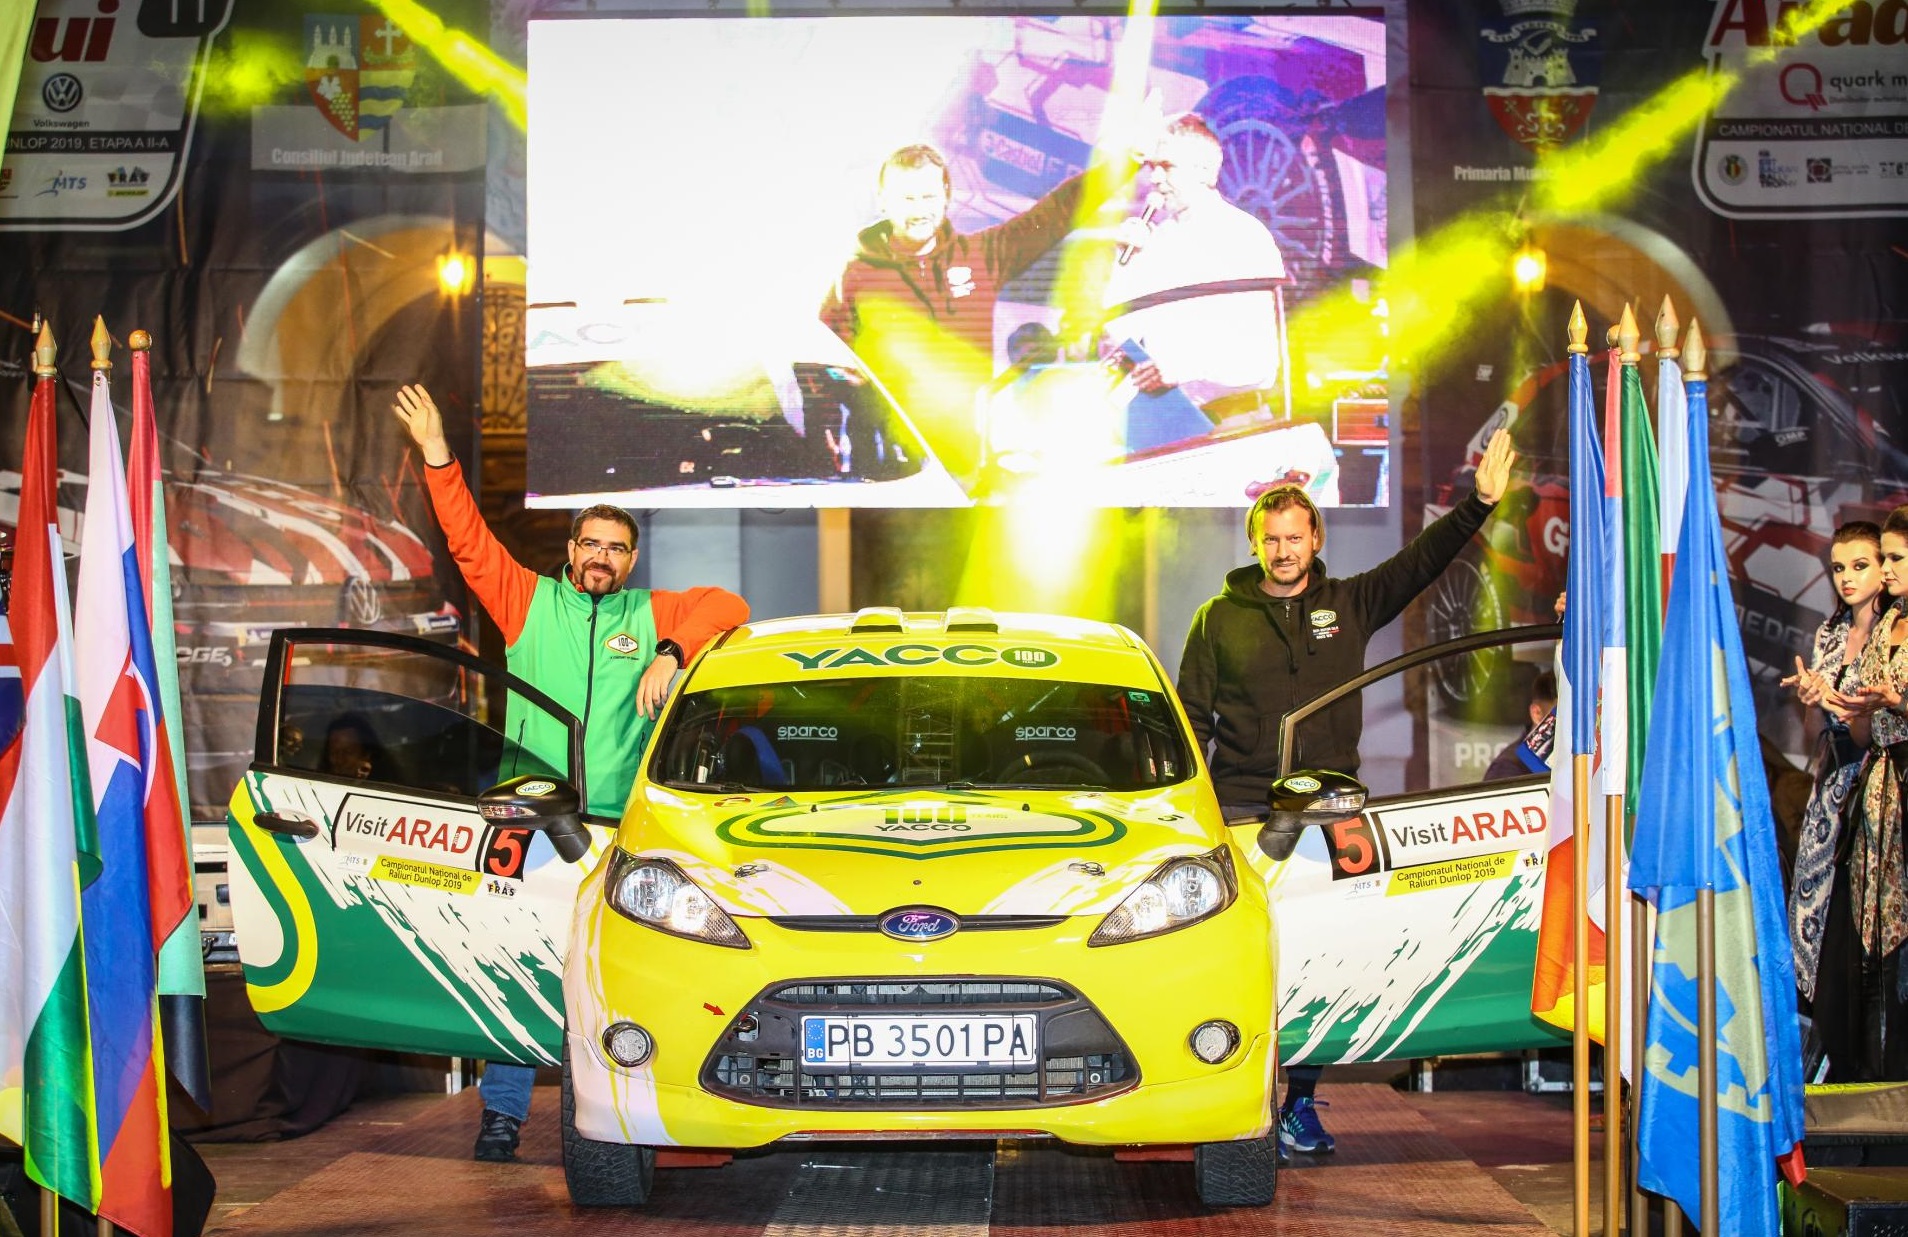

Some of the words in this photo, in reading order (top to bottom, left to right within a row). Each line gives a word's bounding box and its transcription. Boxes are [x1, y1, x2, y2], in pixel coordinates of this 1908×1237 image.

[1830, 70, 1885, 92] quark
[34, 119, 90, 129] Volkswagen
[1718, 125, 1818, 137] CAMPIONATUL
[6, 138, 48, 149] NLOP
[409, 151, 443, 166] Arad
[777, 725, 838, 739] sparco
[1015, 725, 1077, 739] sparco
[522, 784, 551, 792] YACCO
[1290, 780, 1316, 788] YACCO
[345, 811, 388, 837] Visit
[386, 816, 474, 855] ARAD
[875, 824, 972, 832] YACCO
[1391, 822, 1448, 848] Visit
[1451, 805, 1547, 845] ARAD
[488, 828, 530, 877] 5
[1333, 817, 1373, 874] 5
[381, 858, 427, 874] Campionatul
[462, 872, 472, 882] de
[389, 868, 412, 881] Raliuri
[414, 873, 441, 888] Dunlop
[443, 879, 462, 889] 2019
[1397, 867, 1453, 883] Campionatul
[1494, 857, 1506, 866] de
[1409, 879, 1437, 889] Raliuri
[1440, 872, 1472, 885] Dunlop
[1475, 867, 1496, 879] 2019
[899, 912, 940, 933] Ford
[828, 1024, 874, 1057] PB
[887, 1024, 970, 1057] 3501
[983, 1023, 1028, 1057] PA
[807, 1048, 824, 1058] BG
